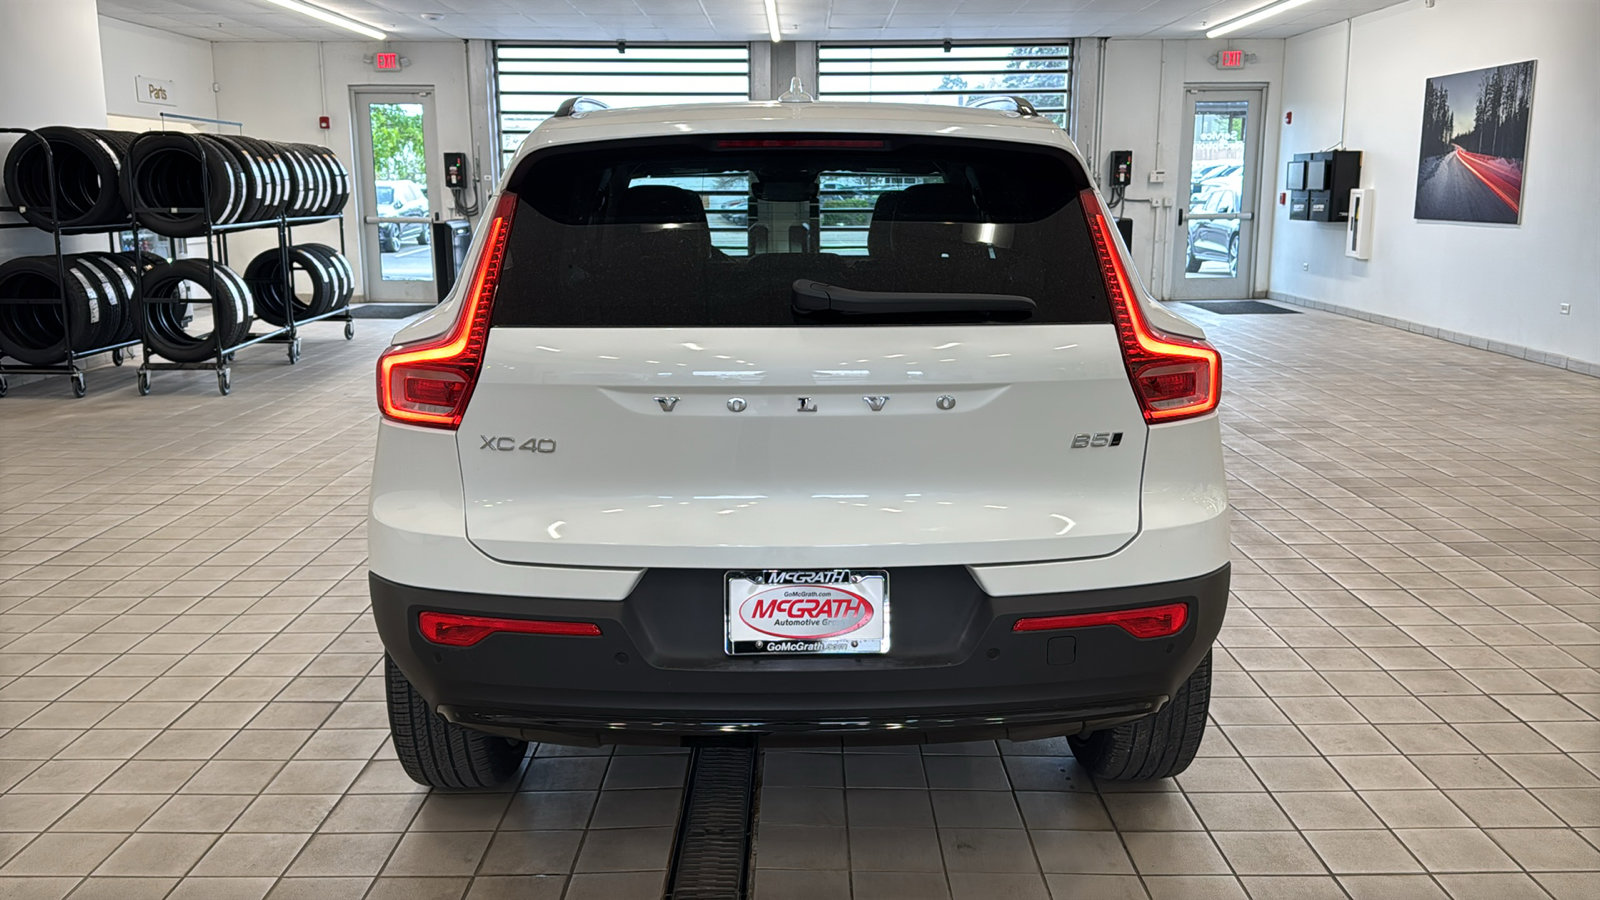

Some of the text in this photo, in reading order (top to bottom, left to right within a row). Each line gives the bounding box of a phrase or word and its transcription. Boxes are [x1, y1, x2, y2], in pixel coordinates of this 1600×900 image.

[377, 52, 397, 68] EXIT
[1222, 50, 1242, 66] EXIT
[148, 83, 168, 100] Parts
[653, 394, 956, 412] VOLVO
[768, 571, 845, 583] McGRATH
[751, 599, 861, 618] McGRATH
[774, 618, 820, 626] Automotive
